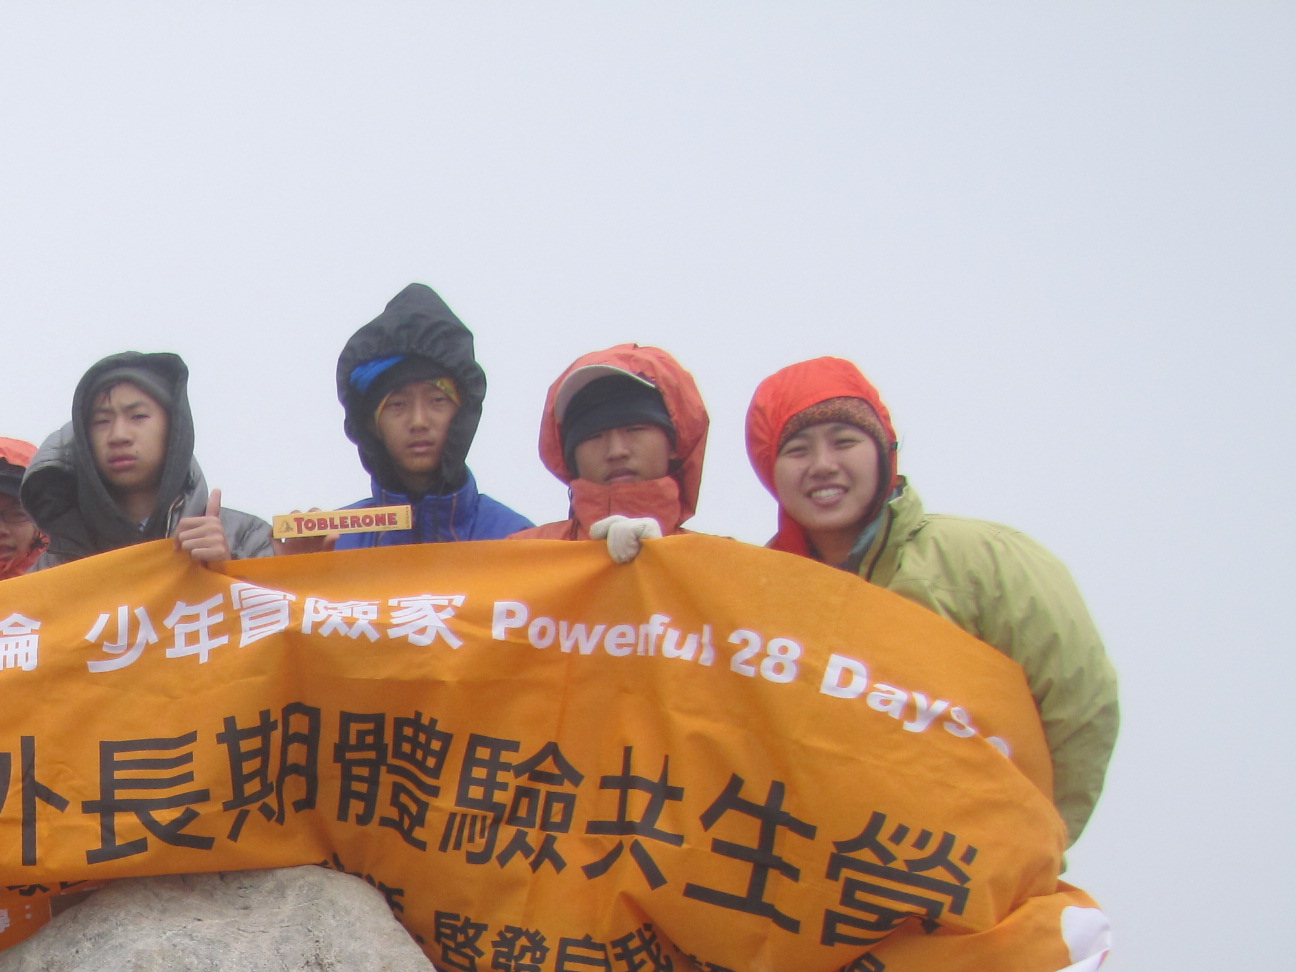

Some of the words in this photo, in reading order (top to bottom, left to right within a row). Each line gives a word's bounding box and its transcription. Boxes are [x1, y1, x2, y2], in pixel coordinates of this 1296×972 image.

[293, 512, 398, 535] TOBLERONE
[85, 583, 465, 674] 少年冒險家
[491, 601, 714, 666] Powerful
[727, 628, 802, 685] 28
[819, 653, 977, 739] Days
